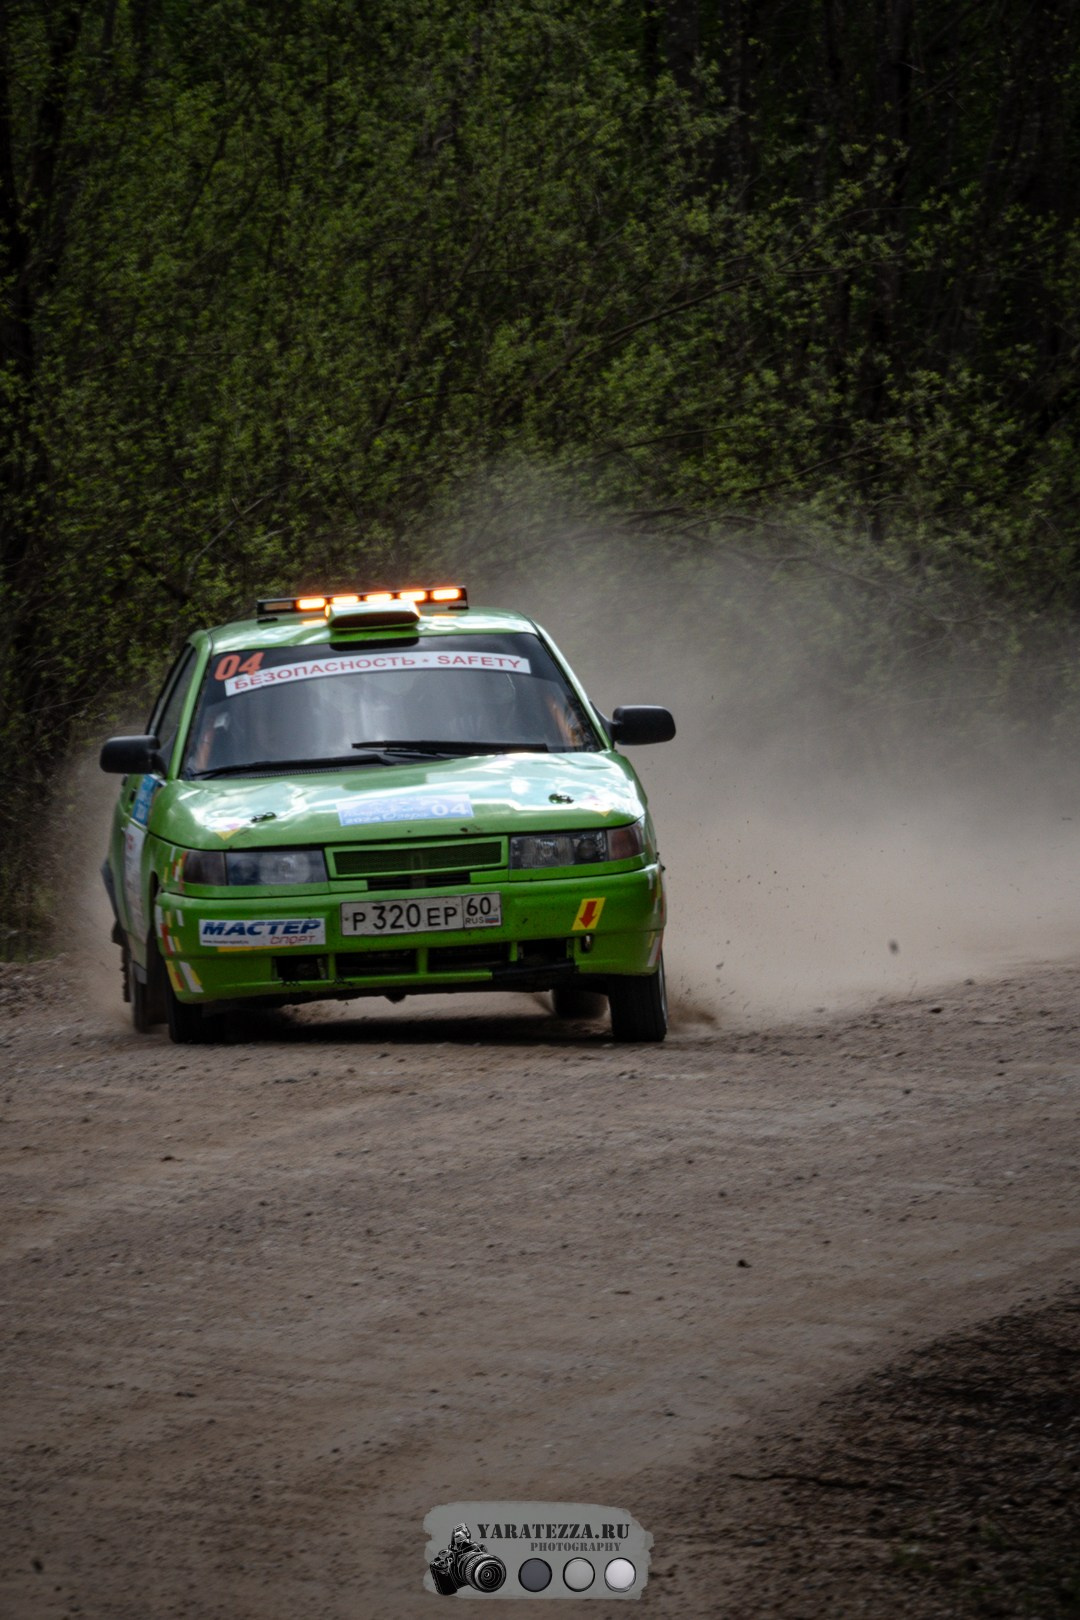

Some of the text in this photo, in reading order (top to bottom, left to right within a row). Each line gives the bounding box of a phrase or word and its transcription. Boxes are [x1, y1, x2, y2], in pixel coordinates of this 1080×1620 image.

[214, 652, 265, 681] 04
[234, 655, 522, 690] БЕЗОПАСНОСТЬ SAFETY
[431, 803, 468, 817] 04
[466, 897, 492, 917] 60
[202, 919, 322, 936] МАСТЕР
[465, 917, 484, 925] RUS
